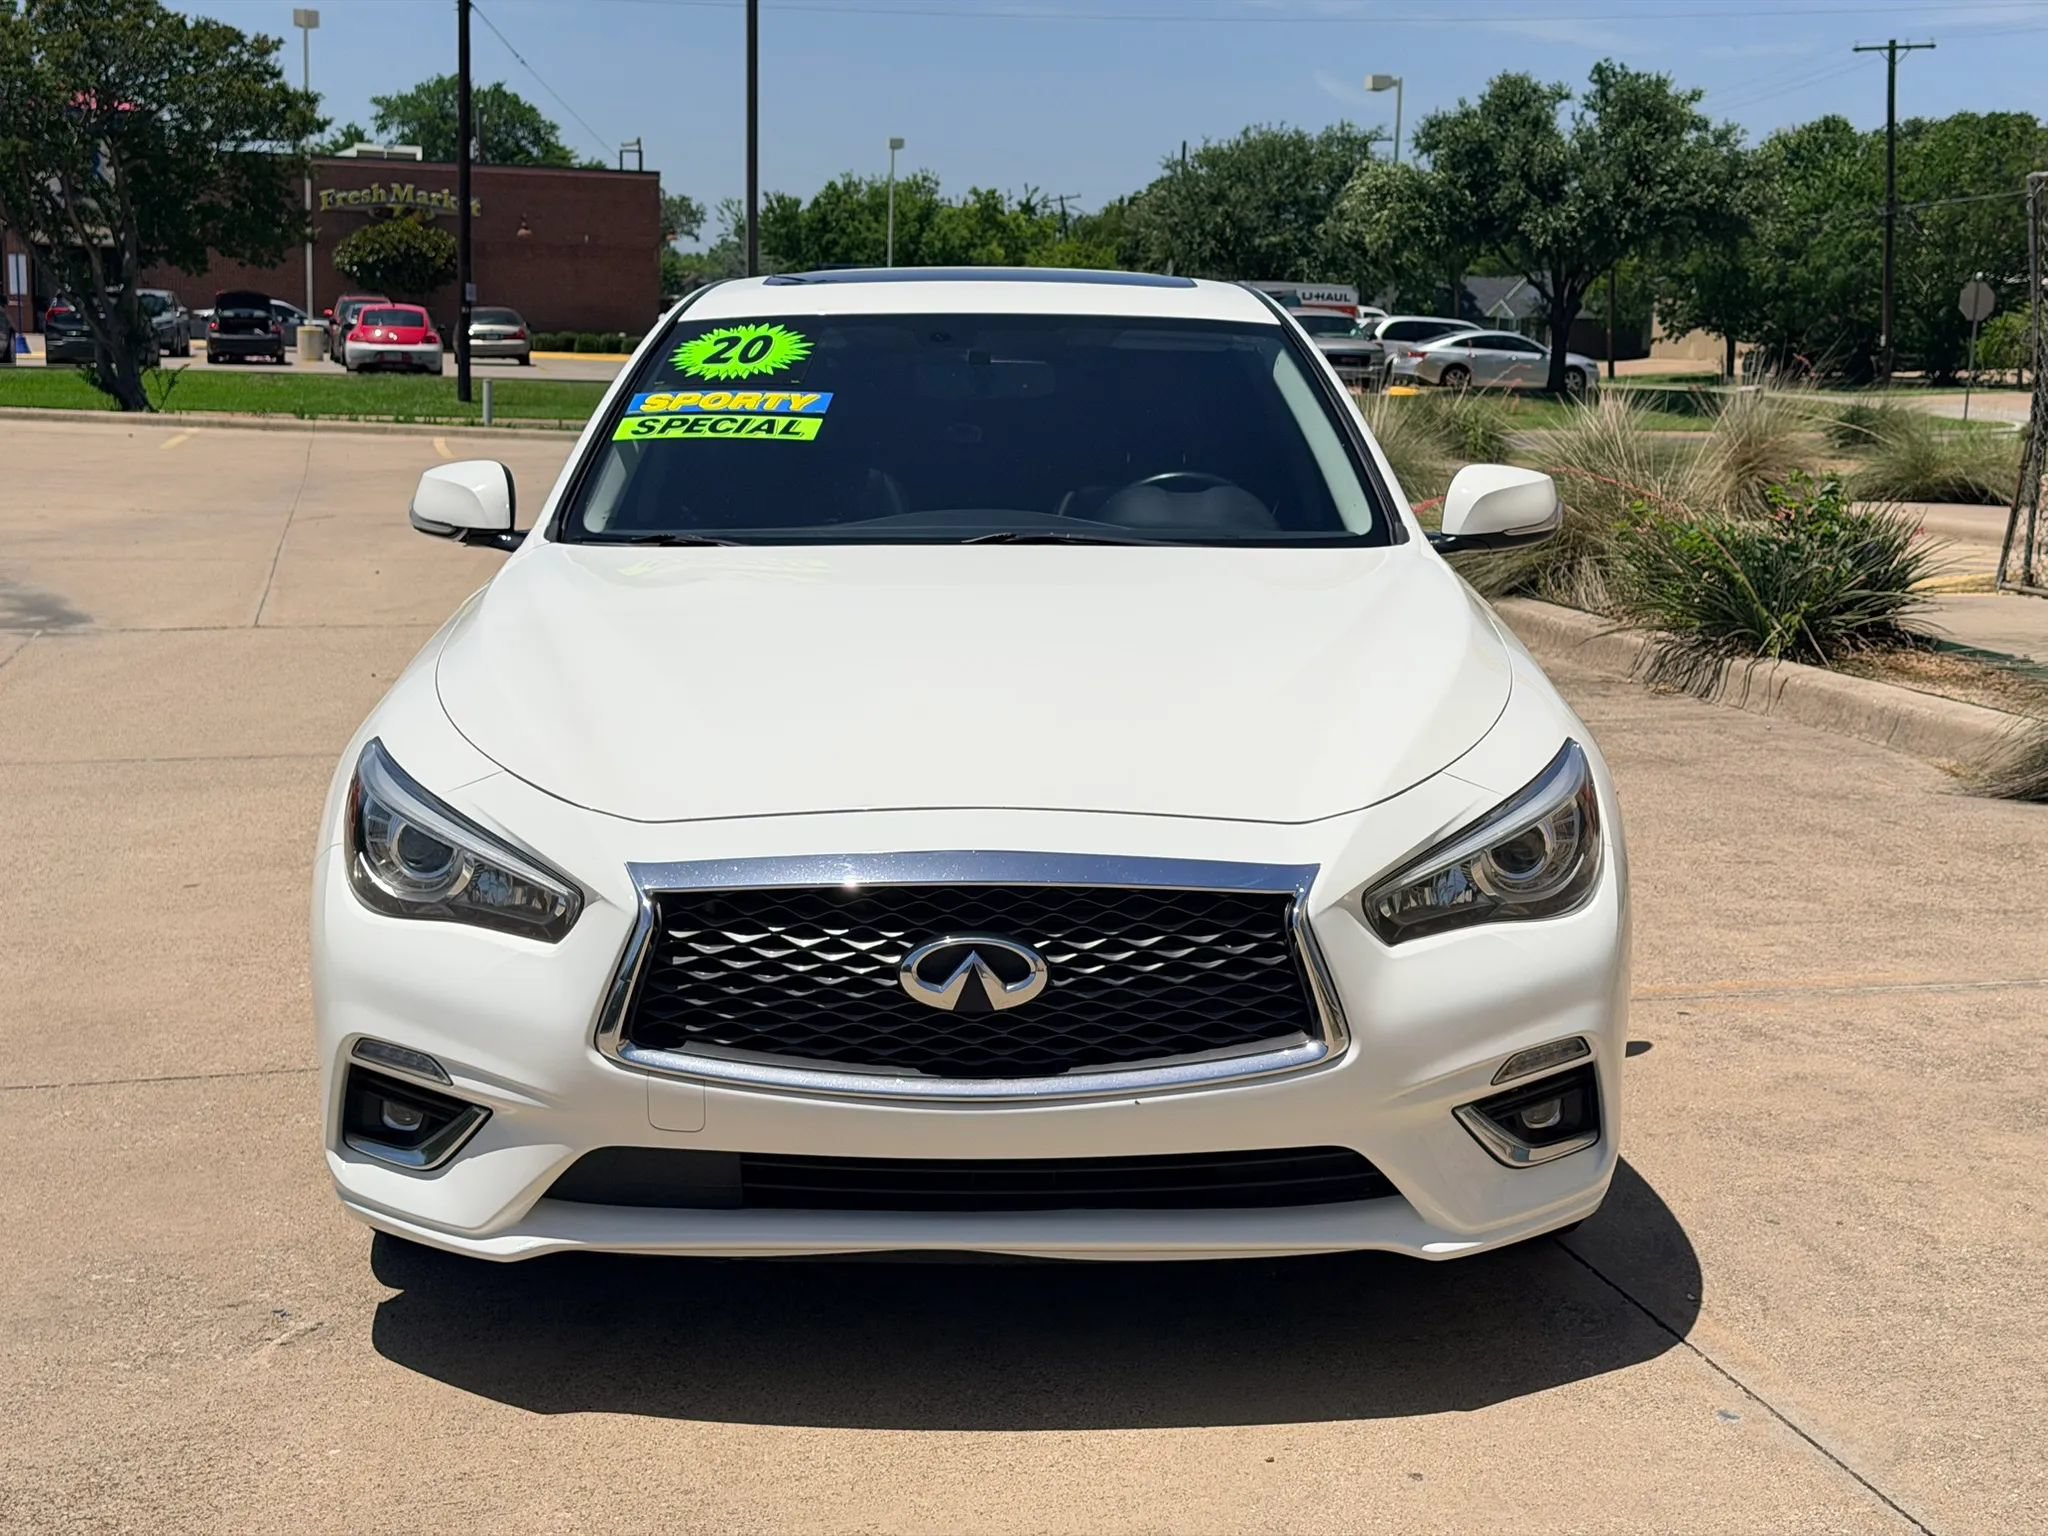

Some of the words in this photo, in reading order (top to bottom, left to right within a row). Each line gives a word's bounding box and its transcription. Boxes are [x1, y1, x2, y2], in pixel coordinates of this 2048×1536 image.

[319, 182, 388, 212] Fresh
[390, 182, 482, 217] Markt
[1302, 291, 1351, 302] U-HAUL
[702, 335, 774, 365] 20
[640, 392, 821, 413] SPORTY
[631, 418, 803, 436] SPECIAL
